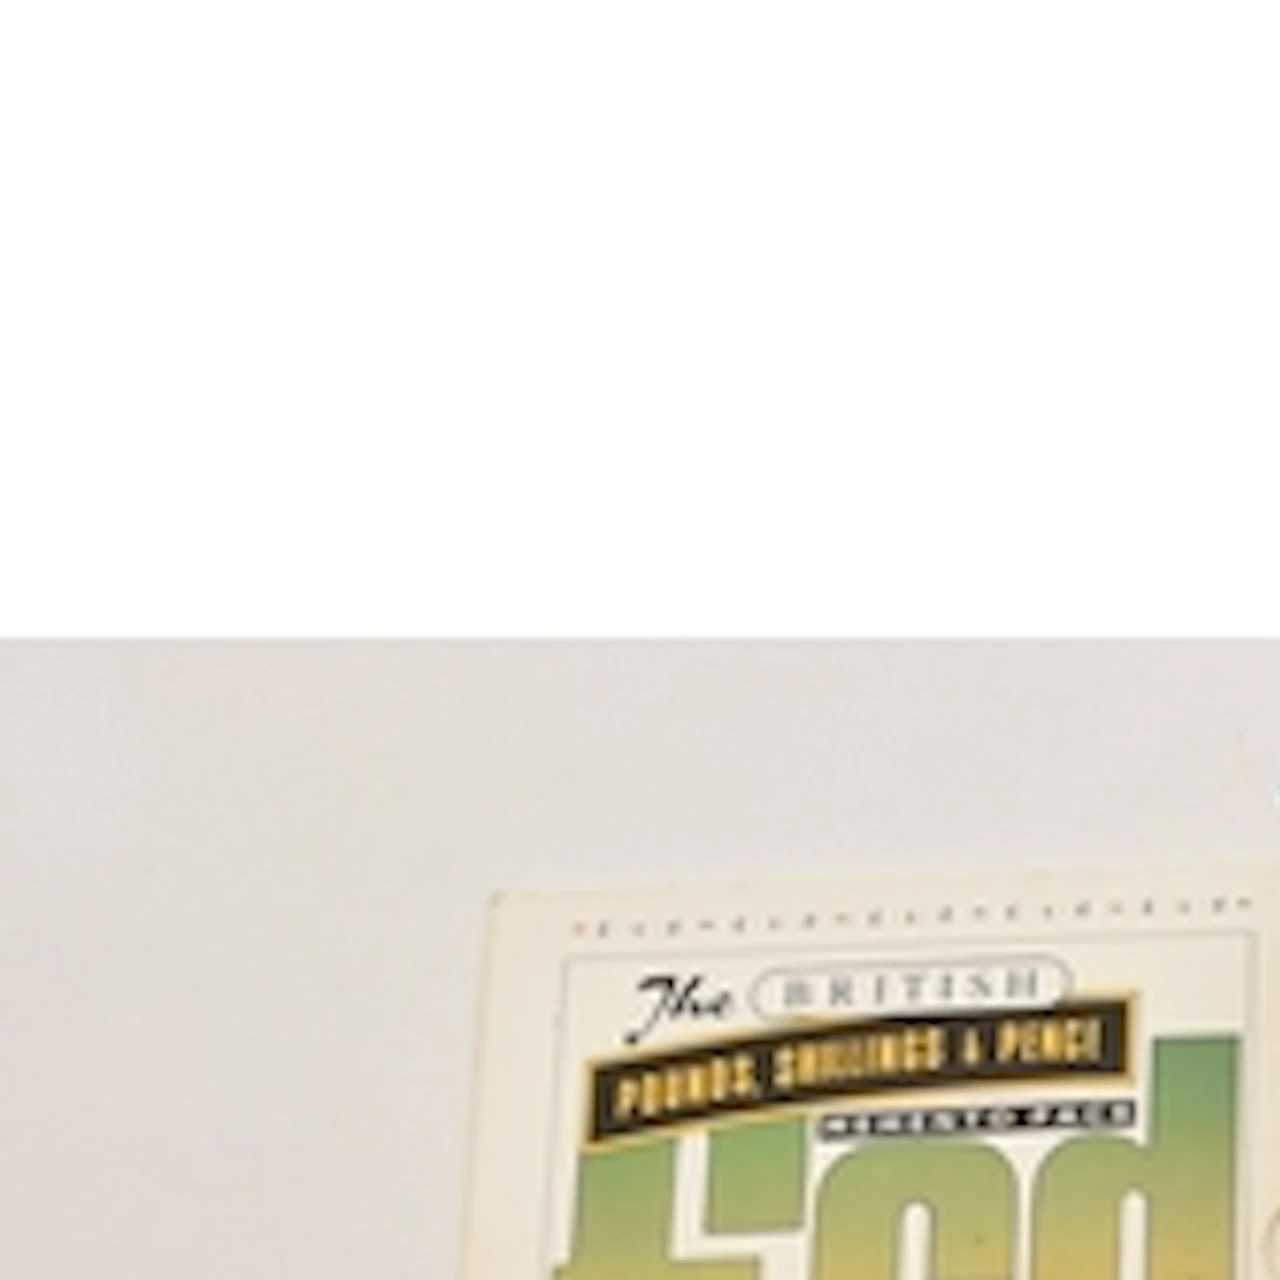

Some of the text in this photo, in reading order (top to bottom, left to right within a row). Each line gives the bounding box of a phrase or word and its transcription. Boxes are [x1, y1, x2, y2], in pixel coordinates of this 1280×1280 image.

[623, 968, 1038, 1044] The BRITISH
[774, 1022, 946, 1088] SHILLINGS
[998, 1015, 1102, 1065] PENCE
